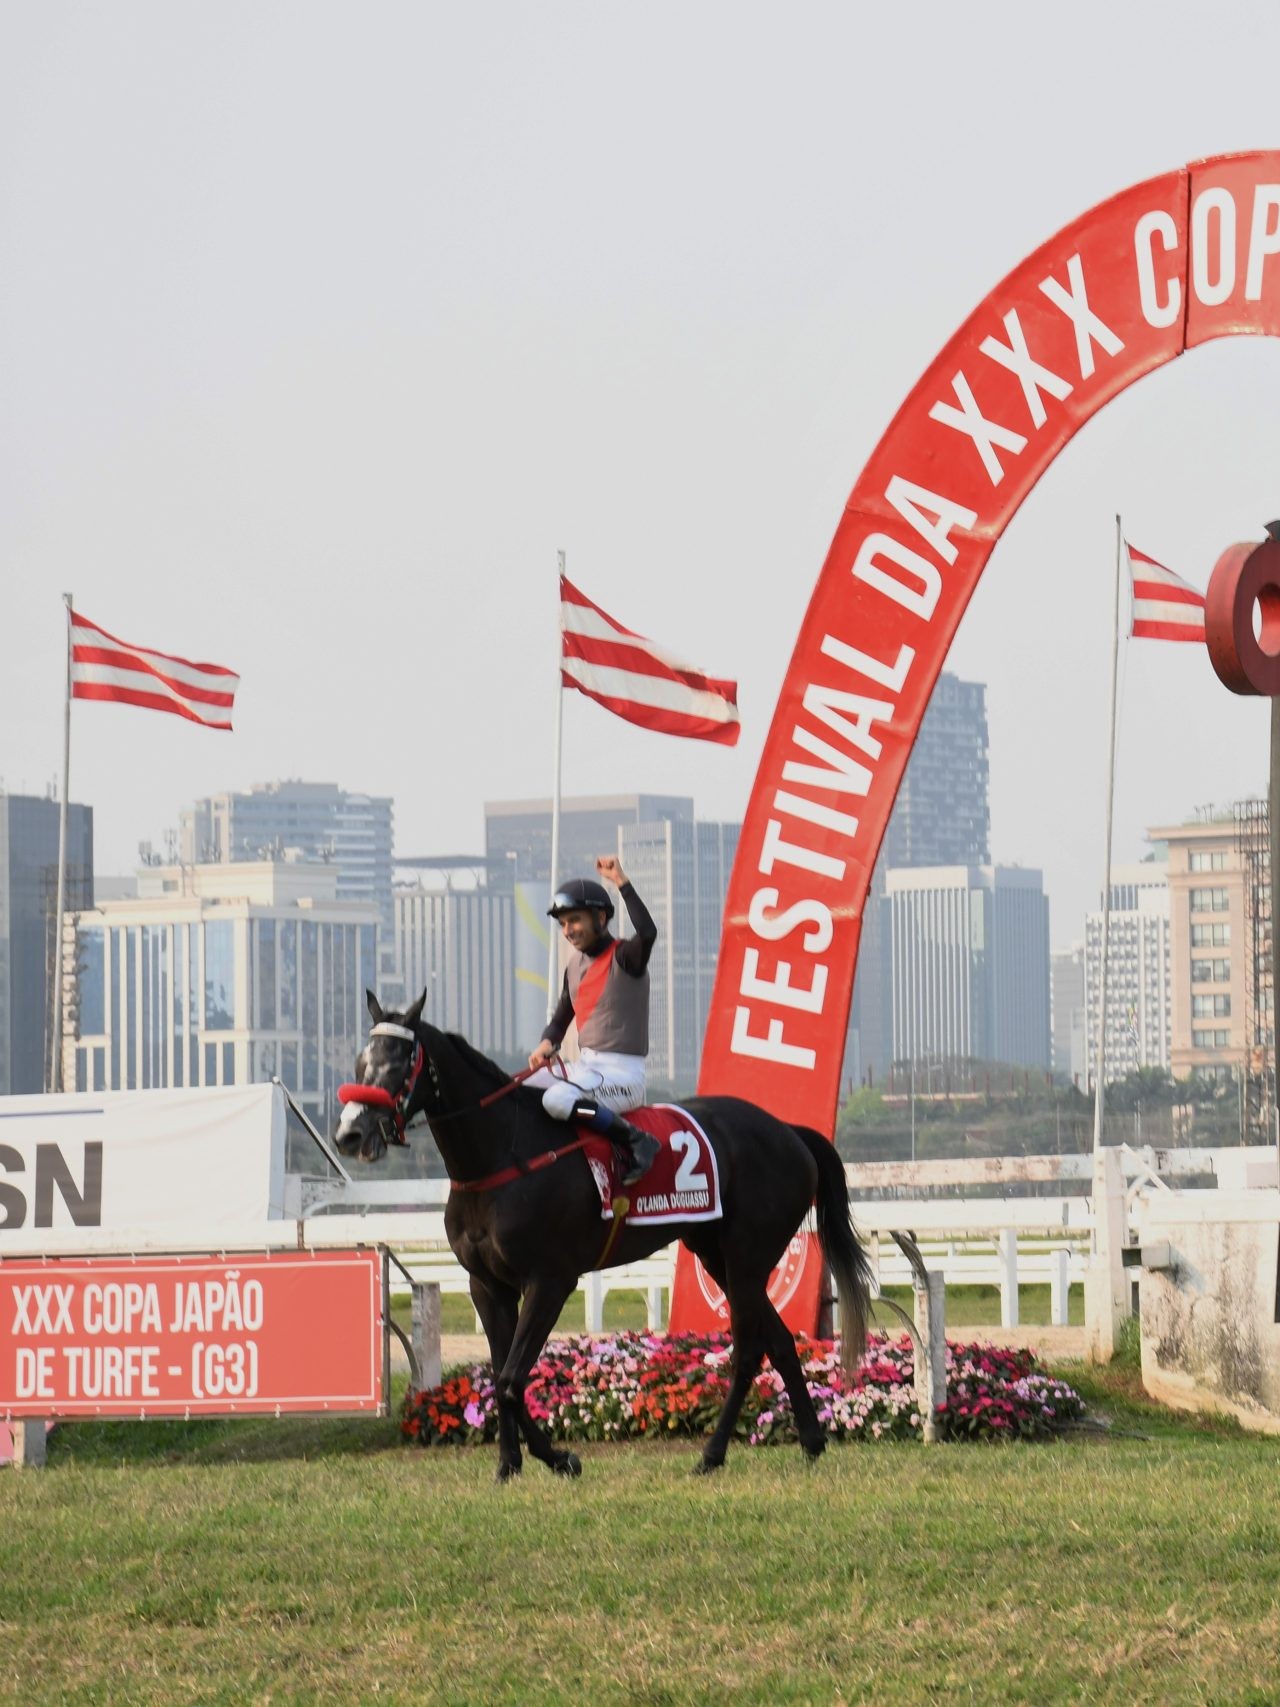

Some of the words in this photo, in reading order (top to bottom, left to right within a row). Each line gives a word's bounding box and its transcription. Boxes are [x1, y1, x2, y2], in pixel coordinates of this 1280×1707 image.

[729, 633, 916, 1071] FESTIVAL
[850, 474, 979, 622] DA
[928, 252, 1126, 488] XXX
[669, 1130, 709, 1191] 2
[11, 1284, 75, 1335] XXX
[83, 1282, 162, 1334] COPA
[169, 1270, 264, 1333] JAPÃO
[15, 1347, 56, 1398] DE
[63, 1345, 161, 1397] TURFE
[168, 1366, 182, 1377] -
[191, 1341, 259, 1399] (G3)
